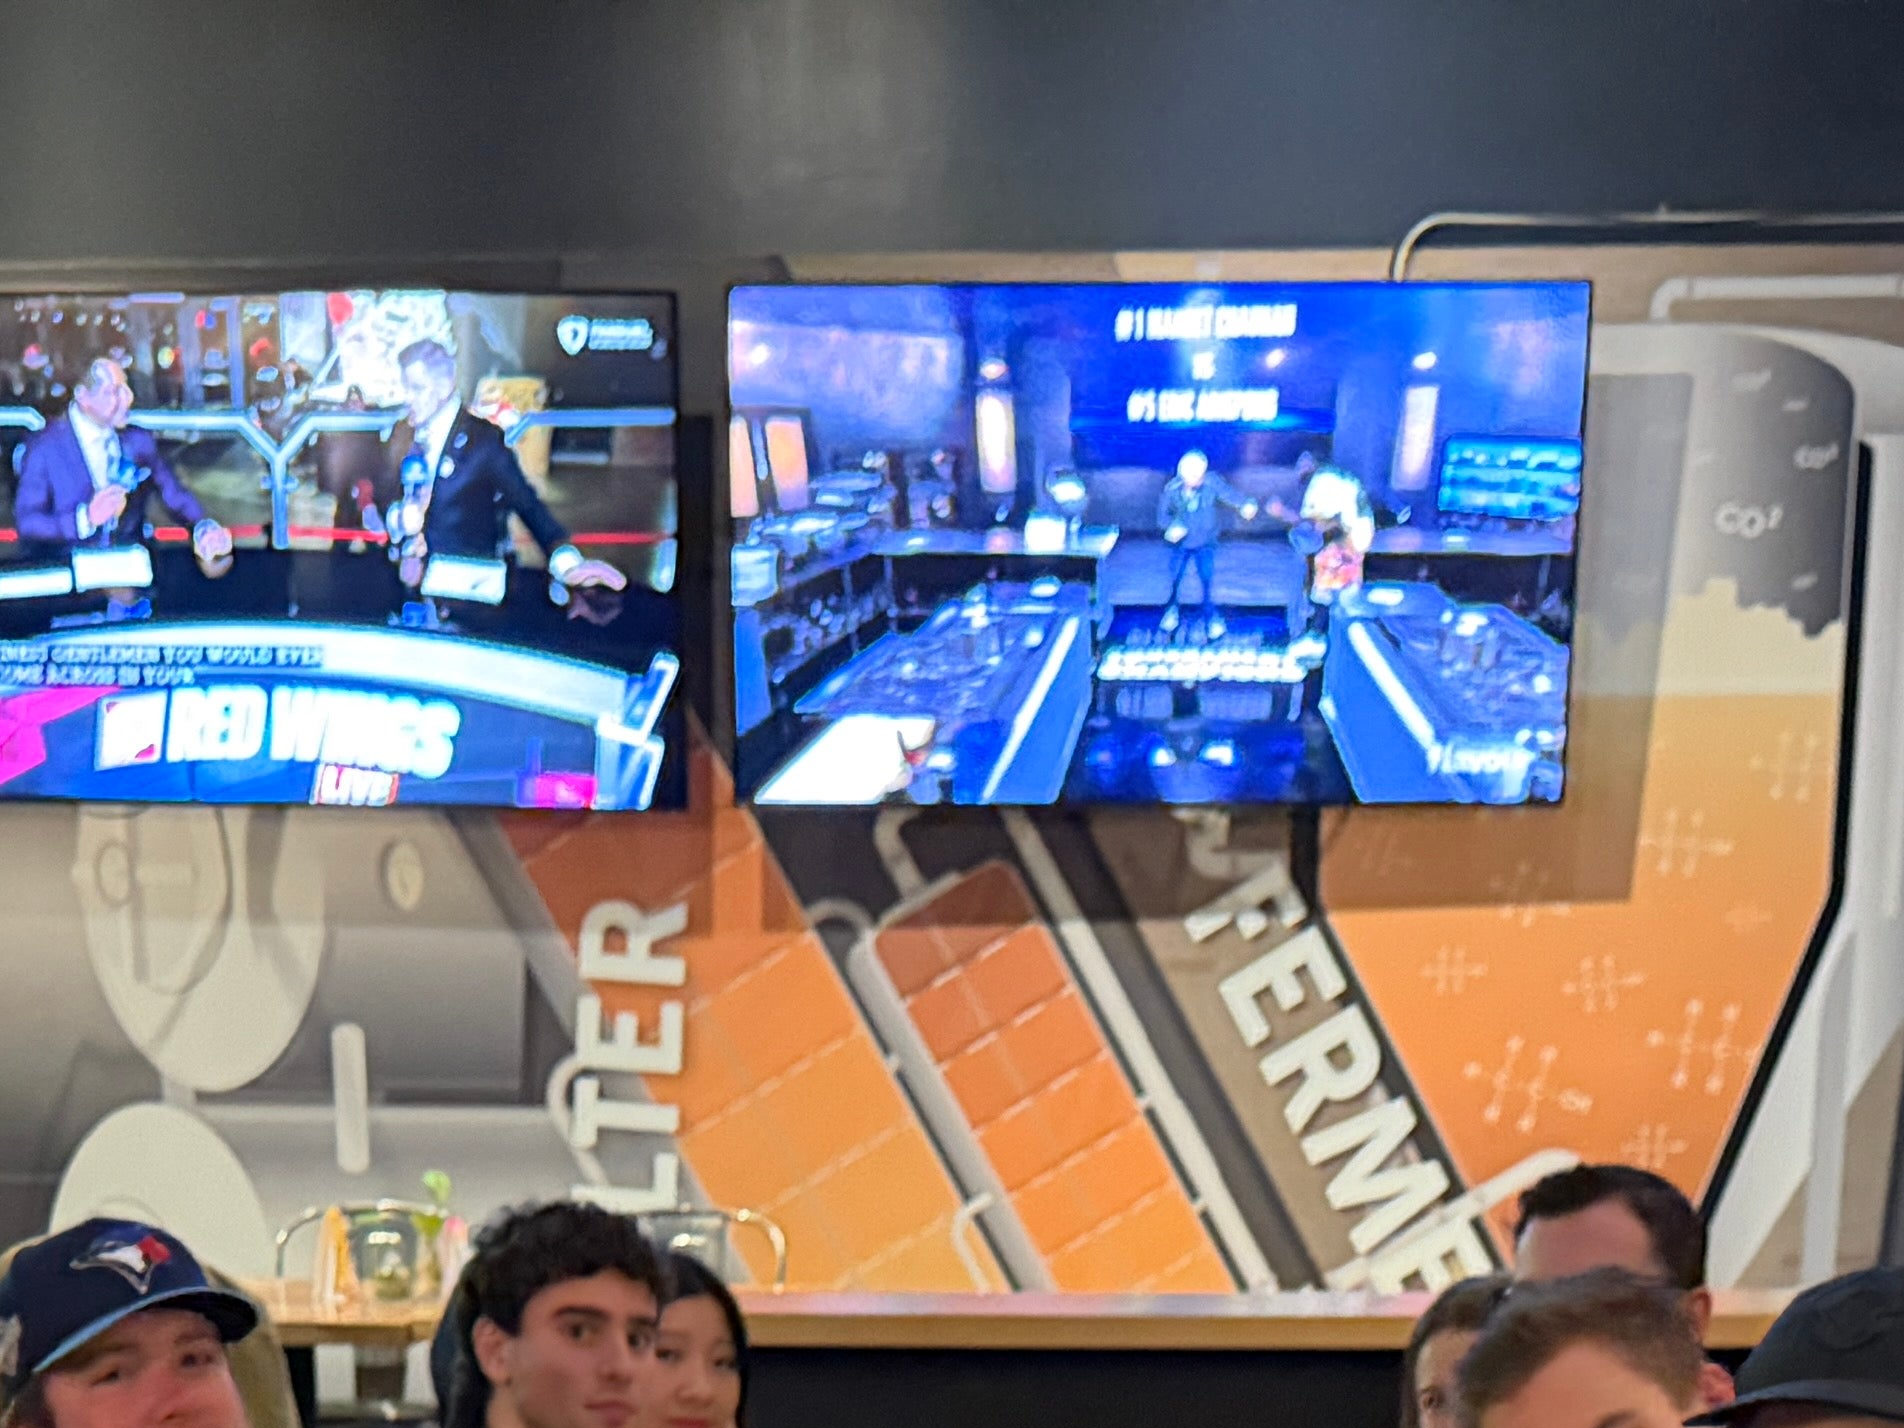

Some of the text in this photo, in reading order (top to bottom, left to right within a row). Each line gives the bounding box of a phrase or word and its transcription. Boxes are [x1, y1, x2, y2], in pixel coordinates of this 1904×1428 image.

[164, 684, 460, 779] RED WINGS
[318, 765, 398, 806] LIVE
[570, 900, 688, 1214] LTER
[1184, 861, 1494, 1295] FERME
